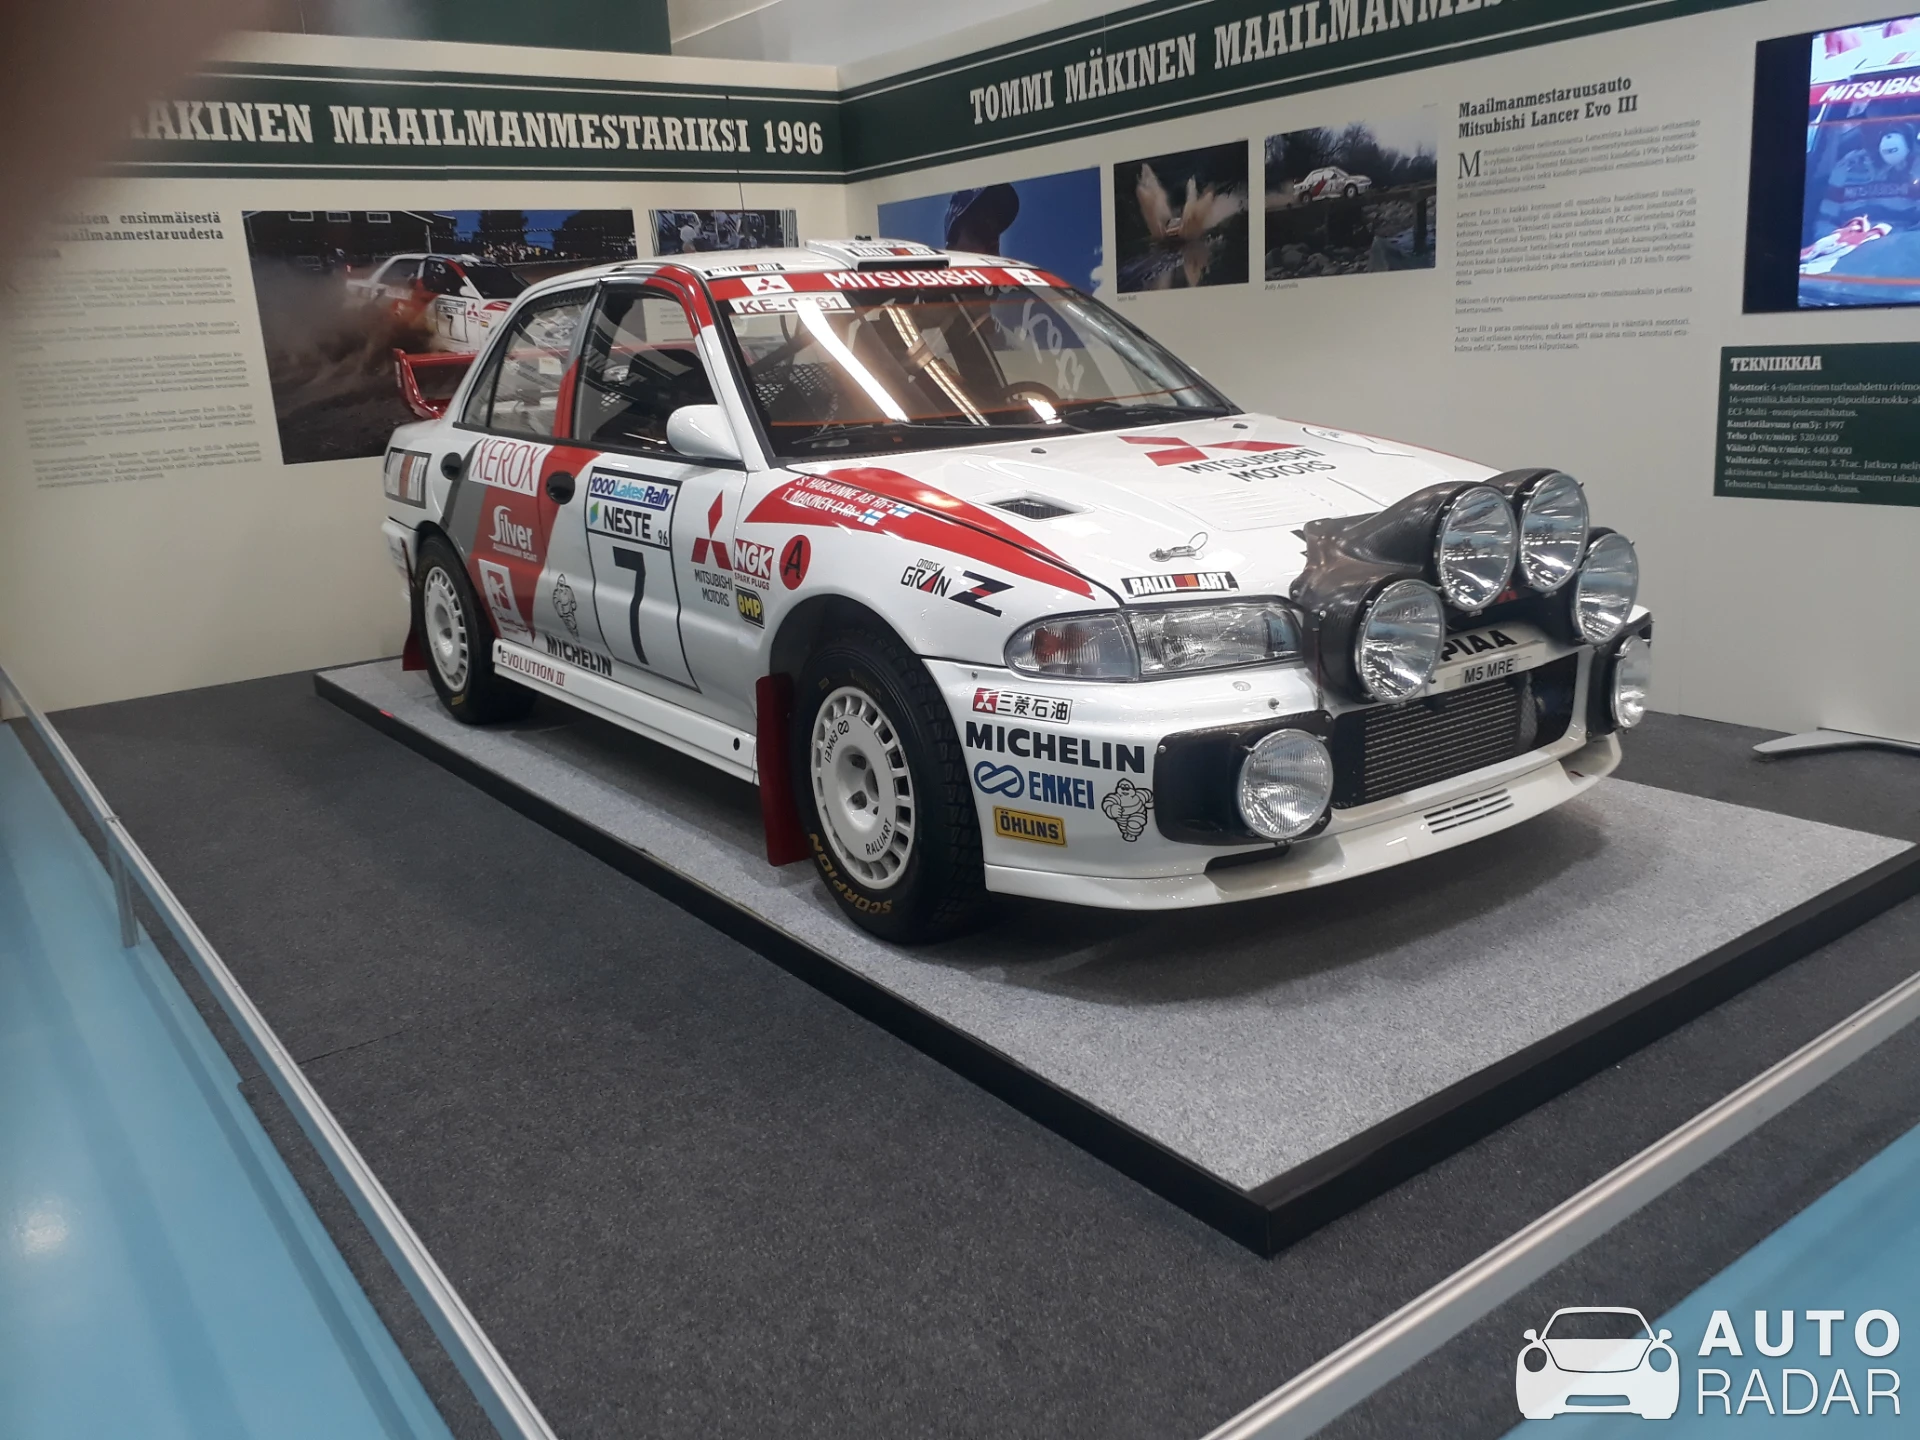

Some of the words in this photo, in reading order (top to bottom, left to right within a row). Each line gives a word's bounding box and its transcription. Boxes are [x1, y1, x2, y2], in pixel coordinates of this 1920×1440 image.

[970, 70, 1054, 125] TOMMI
[1064, 33, 1196, 104] MÄKINEN
[1458, 76, 1632, 118] Maailmanmestaruusauto
[333, 104, 749, 155] MAAILMANMESTARIKSI
[764, 120, 823, 156] 1996
[1458, 113, 1525, 139] Mitsubishi
[1531, 108, 1580, 128] Lancer
[1584, 102, 1611, 120] Evo
[1617, 94, 1638, 113] III
[120, 211, 221, 225] ensimmäisestä
[823, 269, 992, 289] MITSUBISHI
[1731, 356, 1822, 371] TEKNIIKKAA
[1825, 421, 1845, 430] 1997
[472, 438, 547, 492] XEROX
[1178, 448, 1325, 475] MITSUBISHI
[1228, 460, 1337, 482] MOTORS
[643, 486, 673, 508] Rally
[806, 477, 856, 500] HARJANNE
[855, 492, 871, 506] AB
[488, 505, 532, 551] Silver
[604, 505, 651, 539] NESTE
[658, 530, 668, 545] 96
[735, 540, 774, 579] NGK
[784, 540, 804, 580] A
[695, 569, 733, 591] MITSUBISHI
[734, 573, 750, 586] SPARK
[751, 576, 770, 590] PLUGS
[901, 566, 952, 597] GRAN
[613, 546, 649, 666] 7
[702, 587, 730, 607] MOTORS
[738, 593, 762, 619] OMP
[545, 634, 613, 677] MICHELIN
[1440, 630, 1518, 662] PIAA
[501, 650, 554, 683] EVOLUTION
[1464, 666, 1484, 684] M5
[1487, 658, 1515, 678] MRE
[997, 695, 1069, 721] 三菱石油
[825, 729, 839, 763] ENKEI
[966, 721, 1145, 773] MICHELIN
[1029, 771, 1095, 810] ENKEI
[865, 817, 892, 856] RALLIART
[1000, 810, 1059, 840] ÖHLINS
